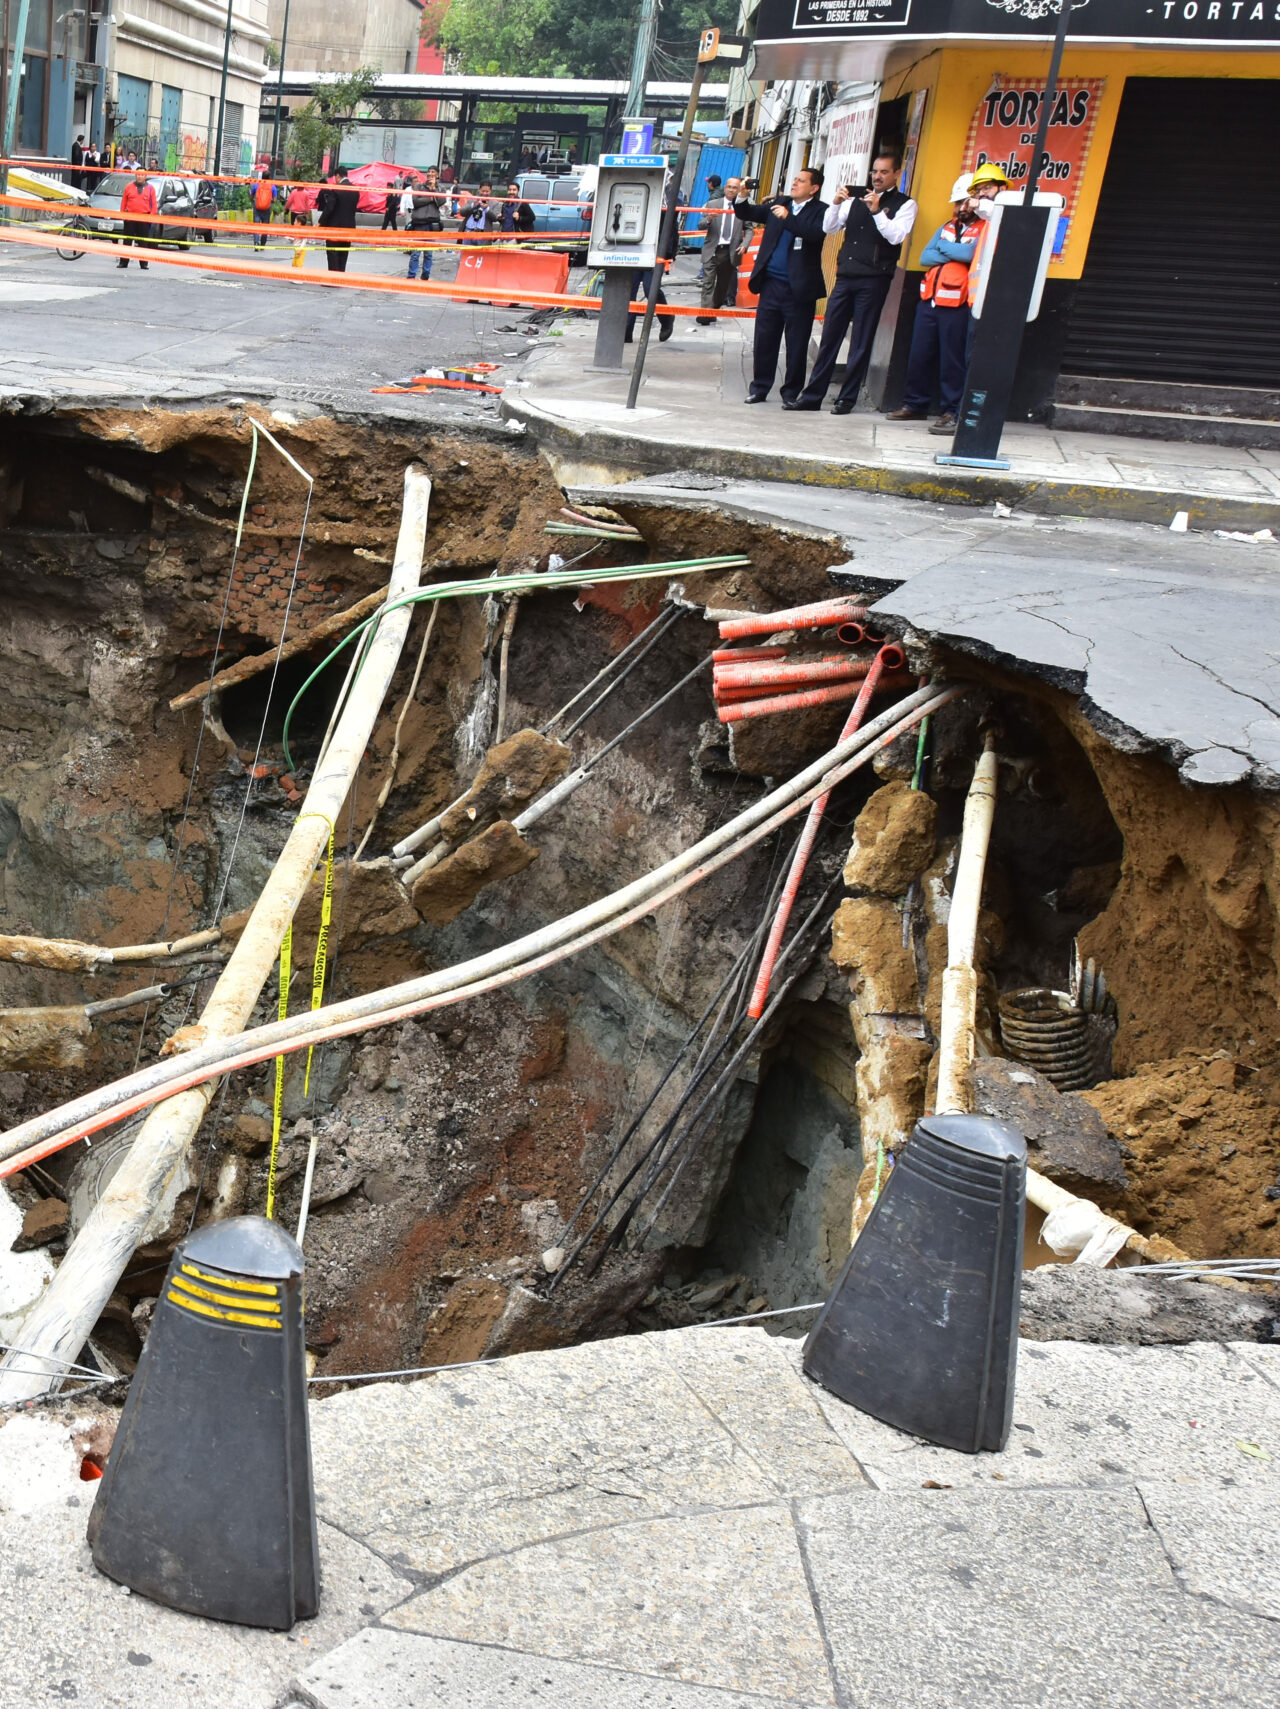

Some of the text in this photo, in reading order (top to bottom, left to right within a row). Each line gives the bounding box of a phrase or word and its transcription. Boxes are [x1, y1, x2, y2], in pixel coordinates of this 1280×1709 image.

[808, 1, 820, 10] LAS
[820, 0, 847, 9] PRIMERAS
[848, 0, 856, 8] EN
[857, 0, 865, 8] LA
[826, 9, 869, 22] DESDE 1892
[1038, 151, 1071, 179] Pavo
[313, 925, 330, 988] PRECAUCION
